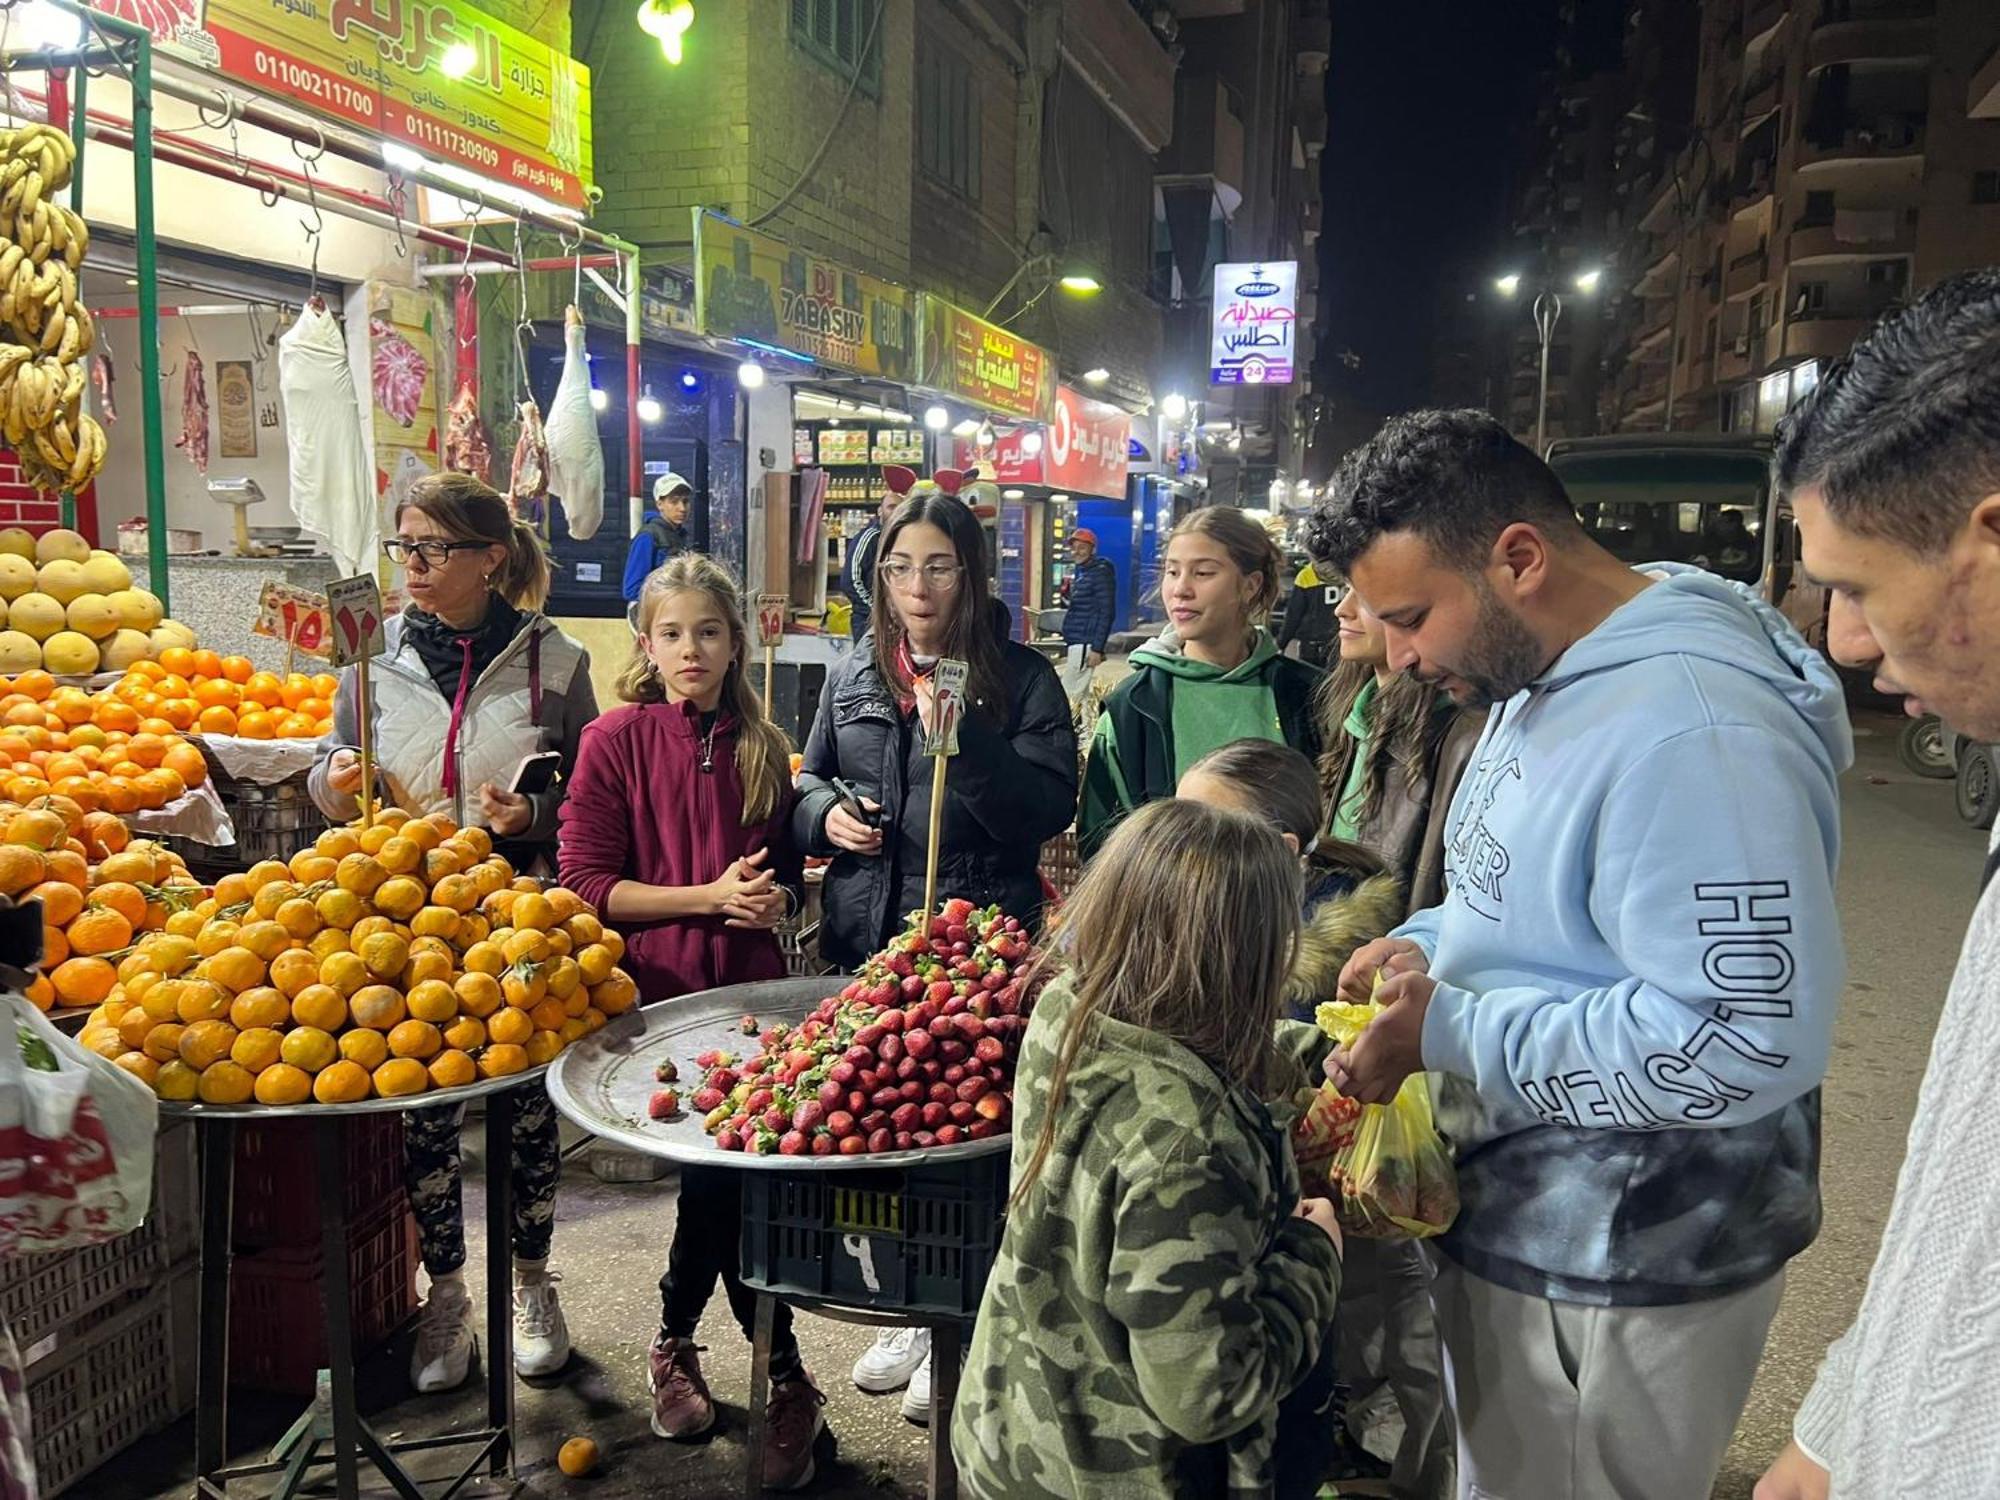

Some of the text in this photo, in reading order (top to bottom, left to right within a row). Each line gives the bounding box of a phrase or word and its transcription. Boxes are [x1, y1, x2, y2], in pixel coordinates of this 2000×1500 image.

[254, 49, 374, 117] 01100211700
[405, 113, 499, 168] 01111730909
[814, 264, 837, 302] DJ
[779, 287, 866, 346] 7ABASHY
[1220, 299, 1297, 329] صيدلية
[1222, 320, 1289, 353] أطلس
[1246, 366, 1262, 378] 24
